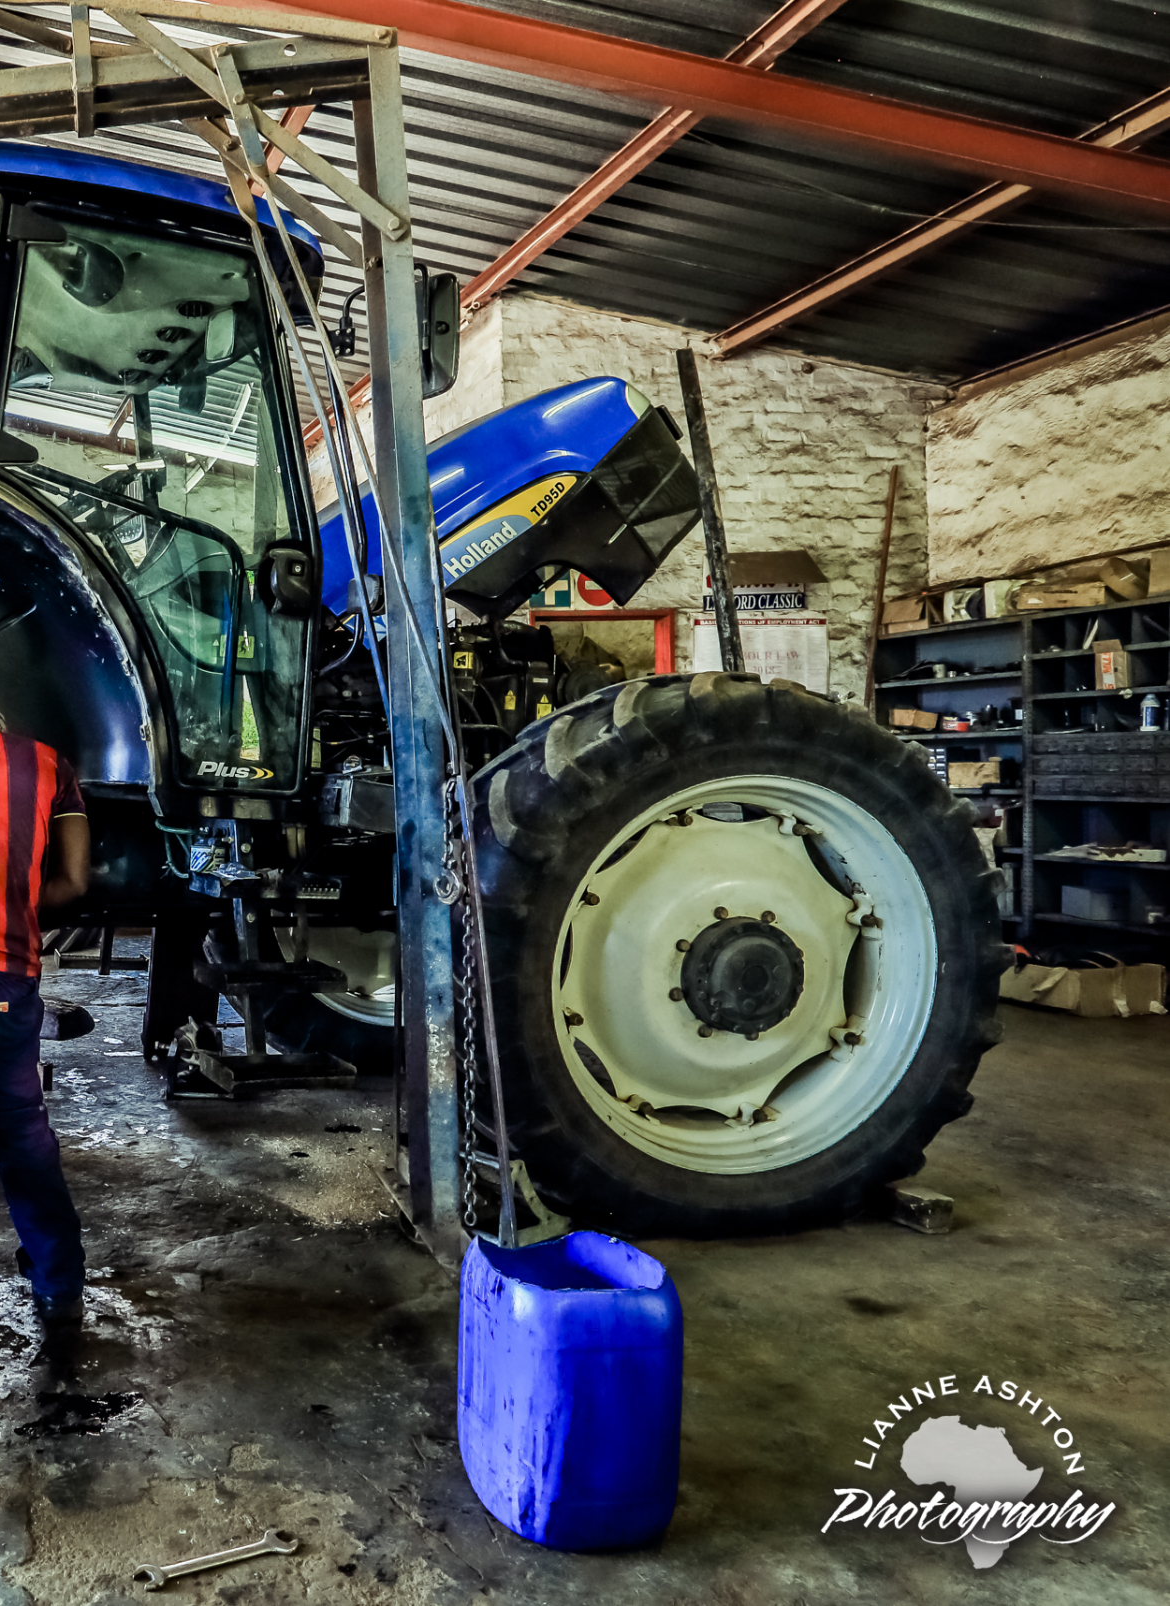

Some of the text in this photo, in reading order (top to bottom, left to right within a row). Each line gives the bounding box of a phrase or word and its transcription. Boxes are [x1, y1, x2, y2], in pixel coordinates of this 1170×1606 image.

[530, 481, 566, 518] TD95D
[443, 520, 518, 579] Holland
[705, 593, 803, 611] LORD CLASSIC
[197, 761, 250, 778] Plus
